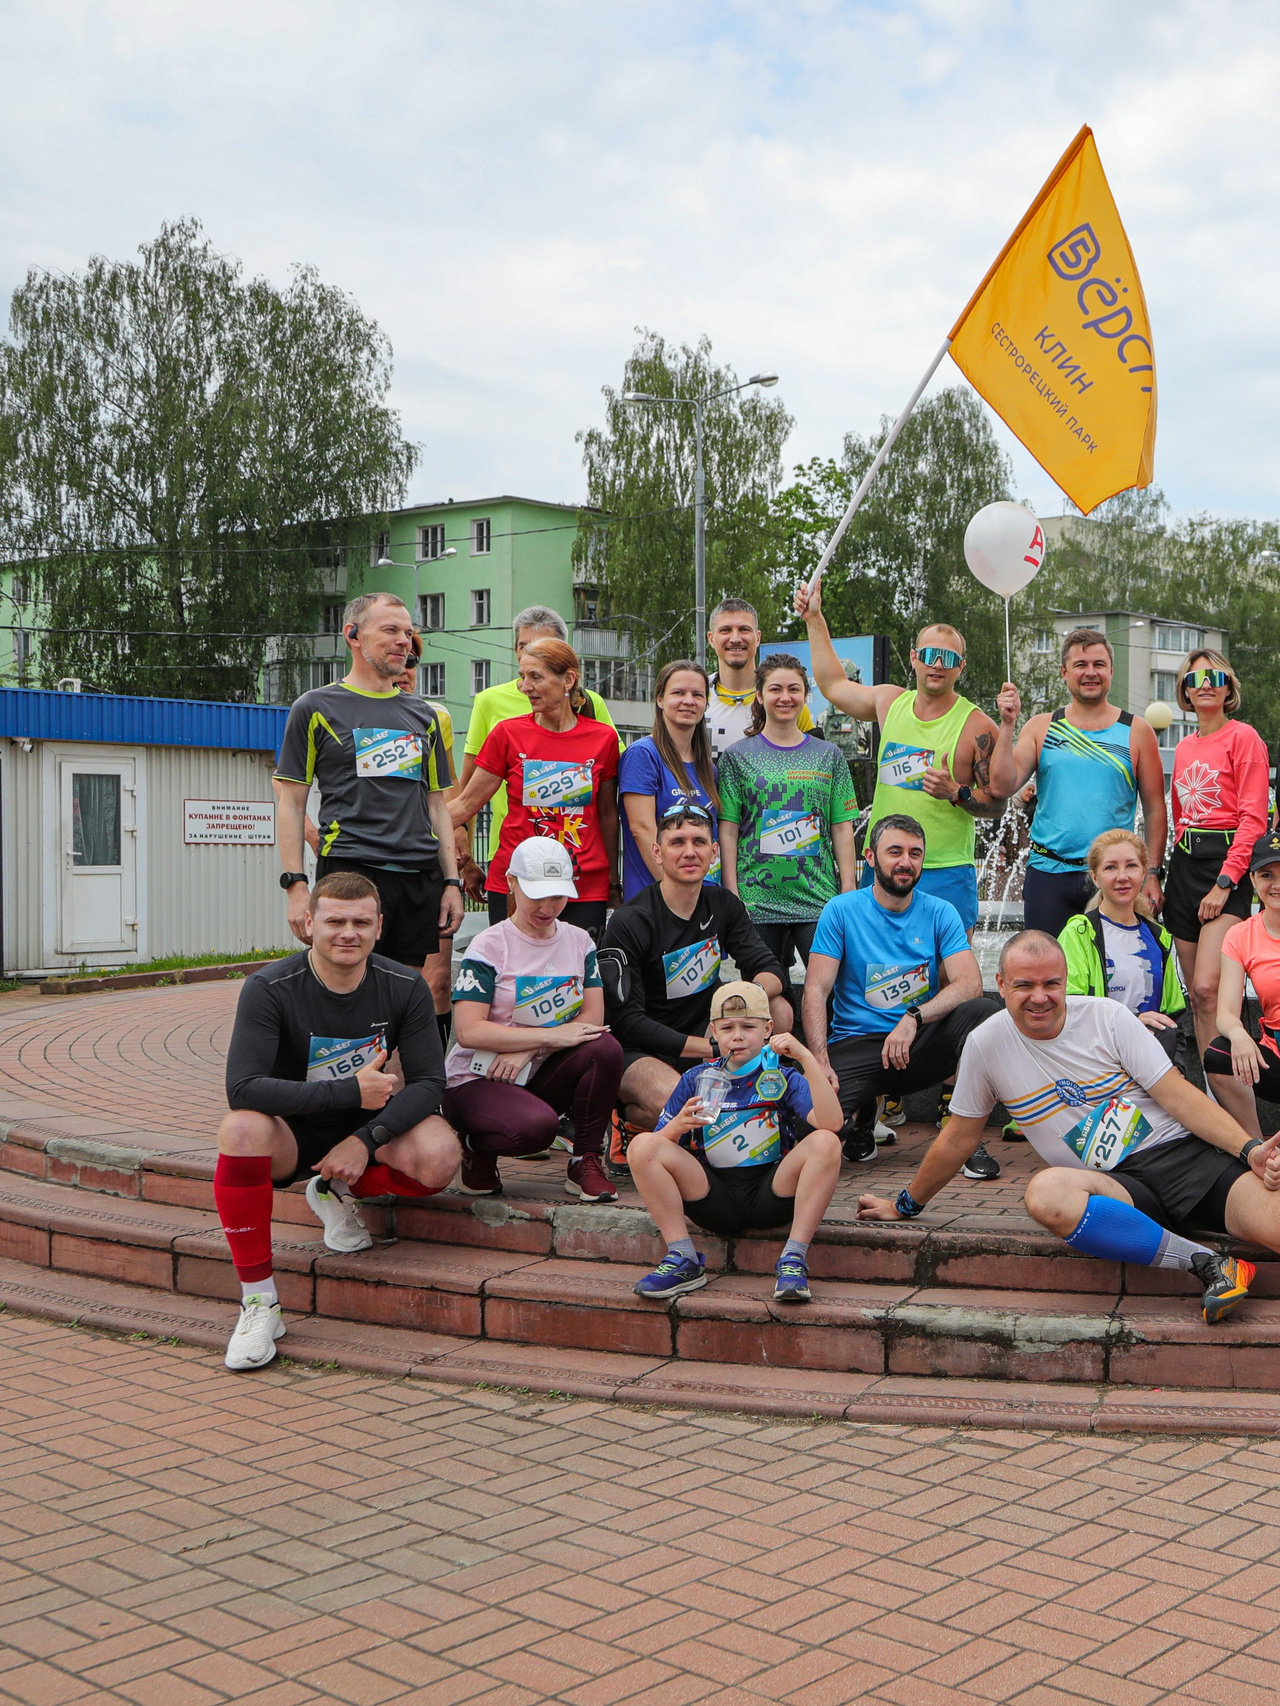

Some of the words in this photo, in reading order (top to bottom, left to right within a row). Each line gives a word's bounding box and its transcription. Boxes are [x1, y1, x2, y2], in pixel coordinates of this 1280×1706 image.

[1033, 325, 1094, 395] КЛИН
[990, 322, 1068, 418] СЕСТРОРЕЦКИЙ
[1065, 416, 1098, 455] ПАРК
[372, 744, 408, 769] 252
[892, 761, 912, 777] 116
[537, 776, 574, 800] 229
[206, 823, 255, 831] ЗАПРЕЩЕНО!
[778, 826, 803, 846] 101
[680, 957, 704, 987] 107
[880, 980, 911, 1001] 139
[530, 993, 566, 1018] 106
[327, 1054, 365, 1078] 168
[732, 1134, 750, 1152] 2
[1094, 1116, 1121, 1162] 257
